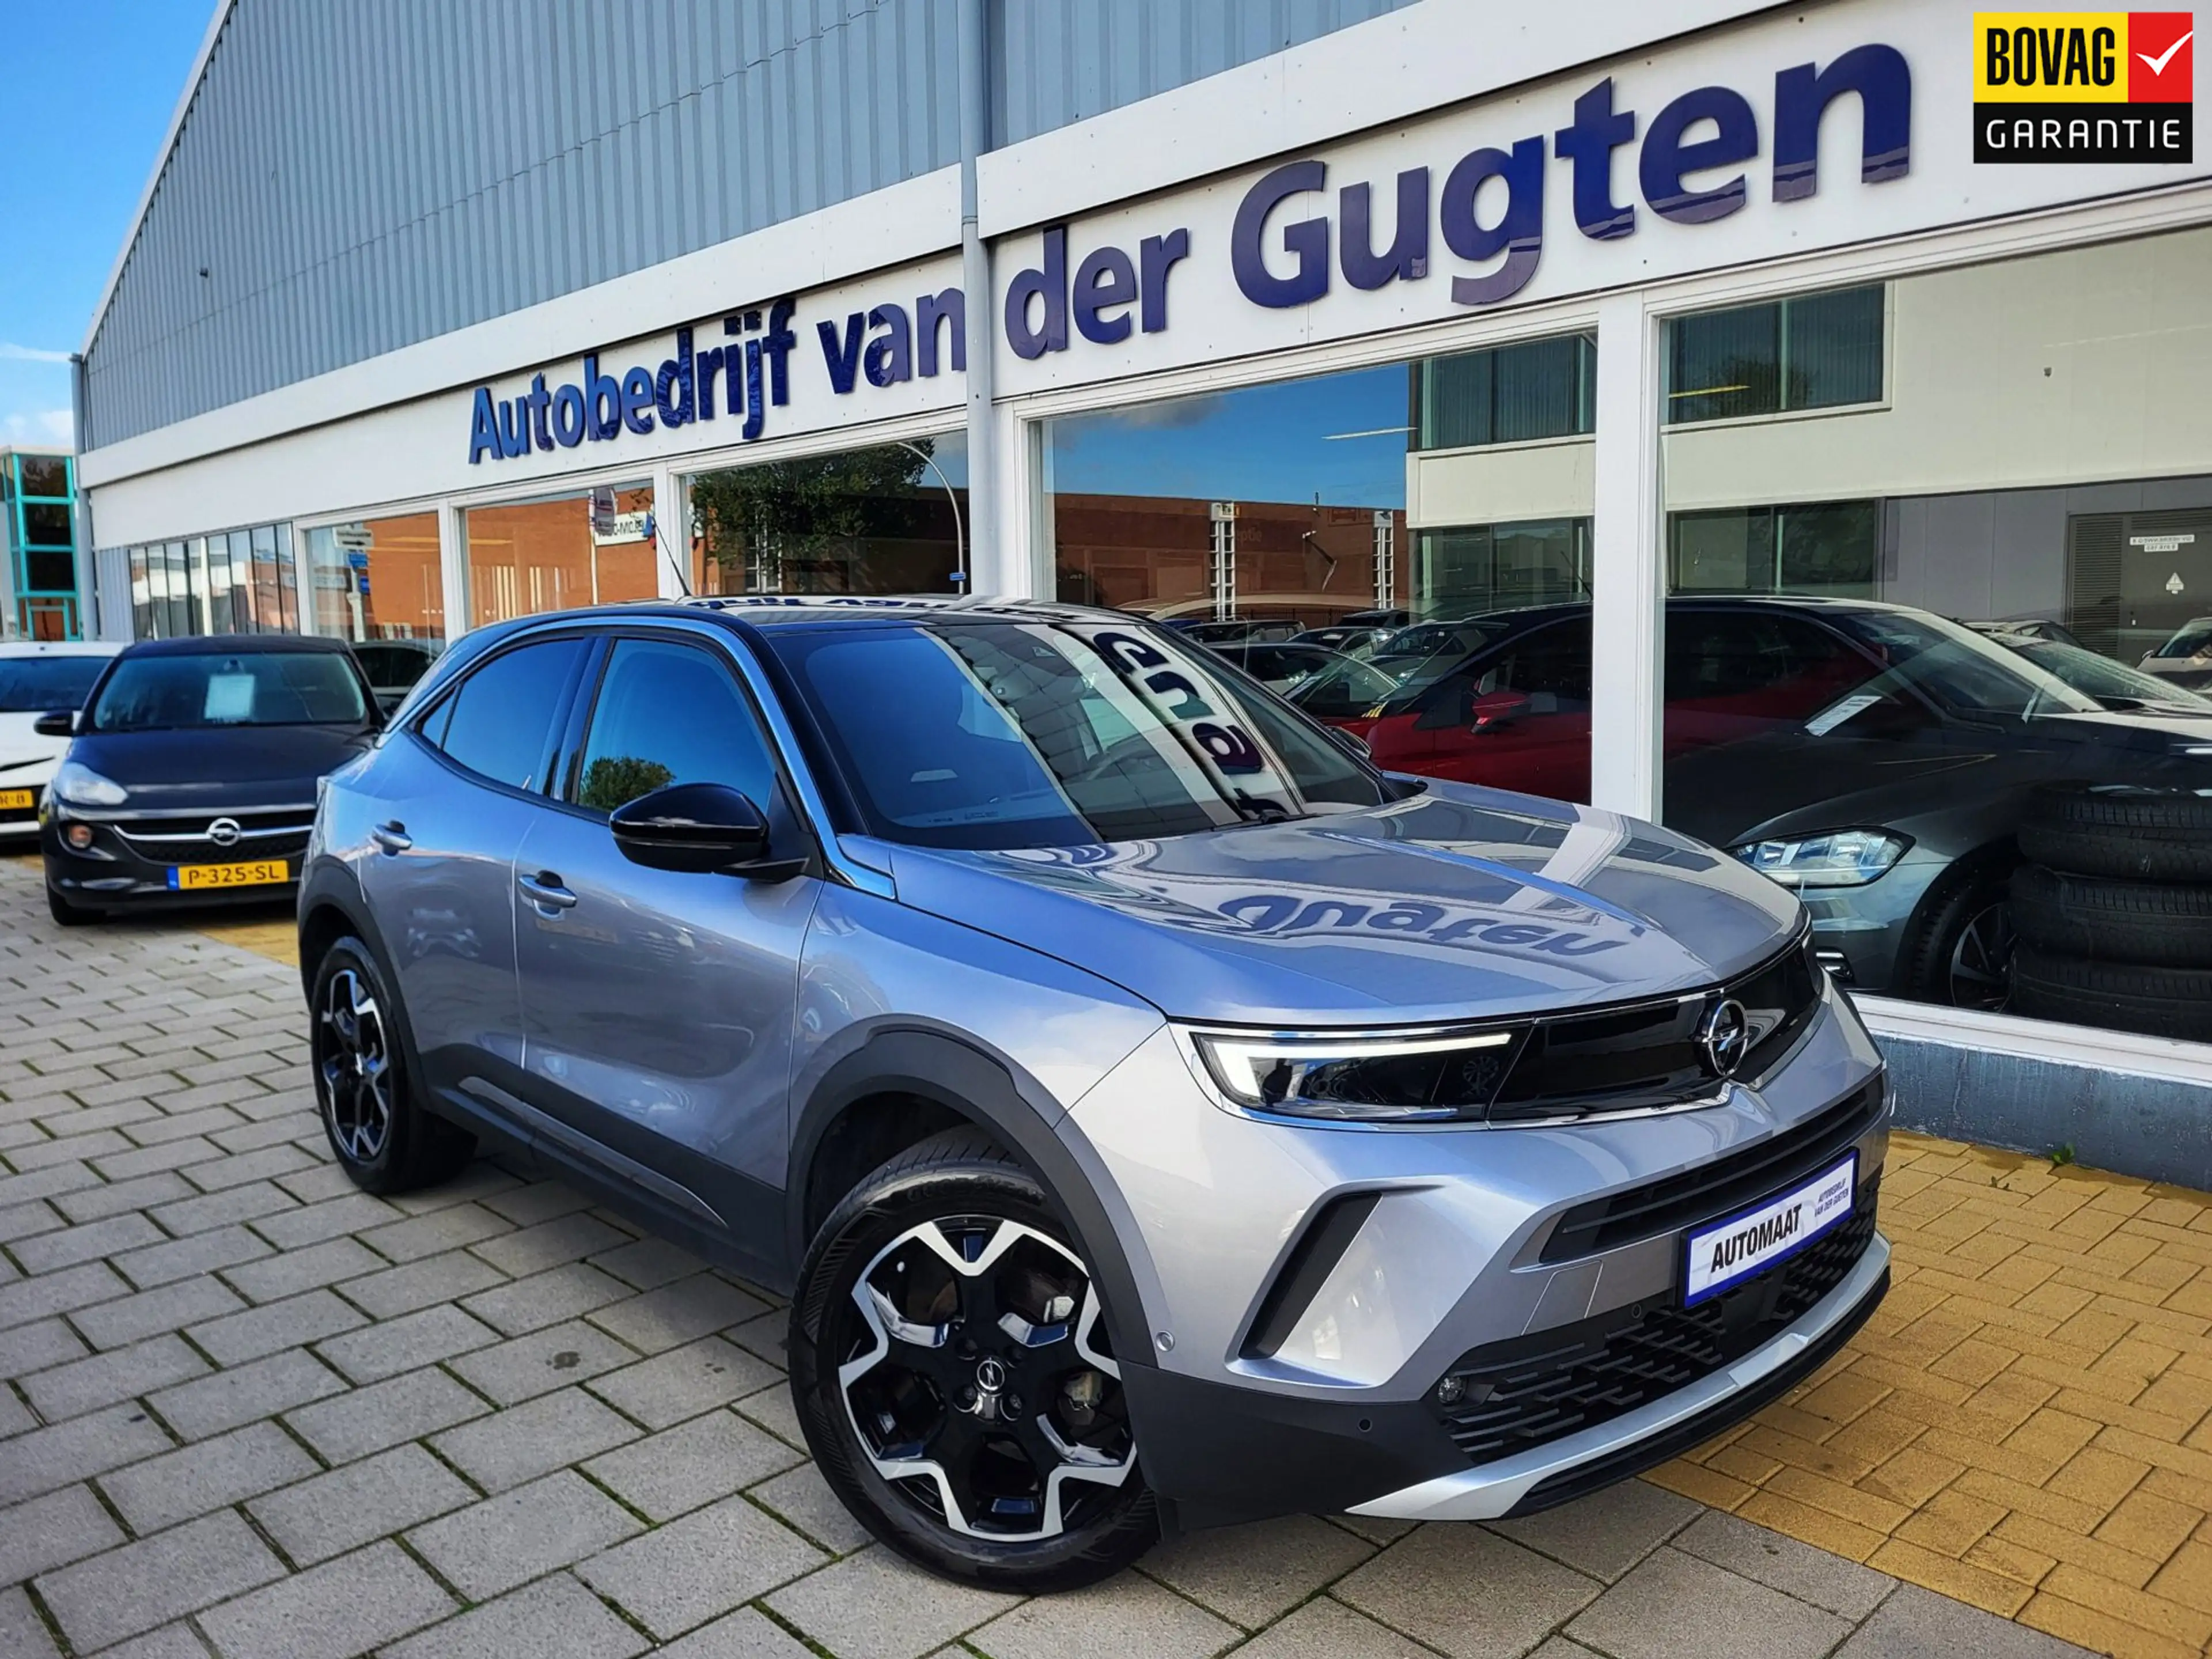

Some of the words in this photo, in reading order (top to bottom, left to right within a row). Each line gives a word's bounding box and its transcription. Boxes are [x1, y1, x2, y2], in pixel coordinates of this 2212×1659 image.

[468, 297, 797, 464] Autobedrijf
[816, 287, 967, 394] van
[1005, 223, 1191, 361] der
[1230, 43, 1912, 310] Gugten
[188, 864, 280, 885] P-325-SL
[1710, 1203, 1802, 1273] AUTOMAAT
